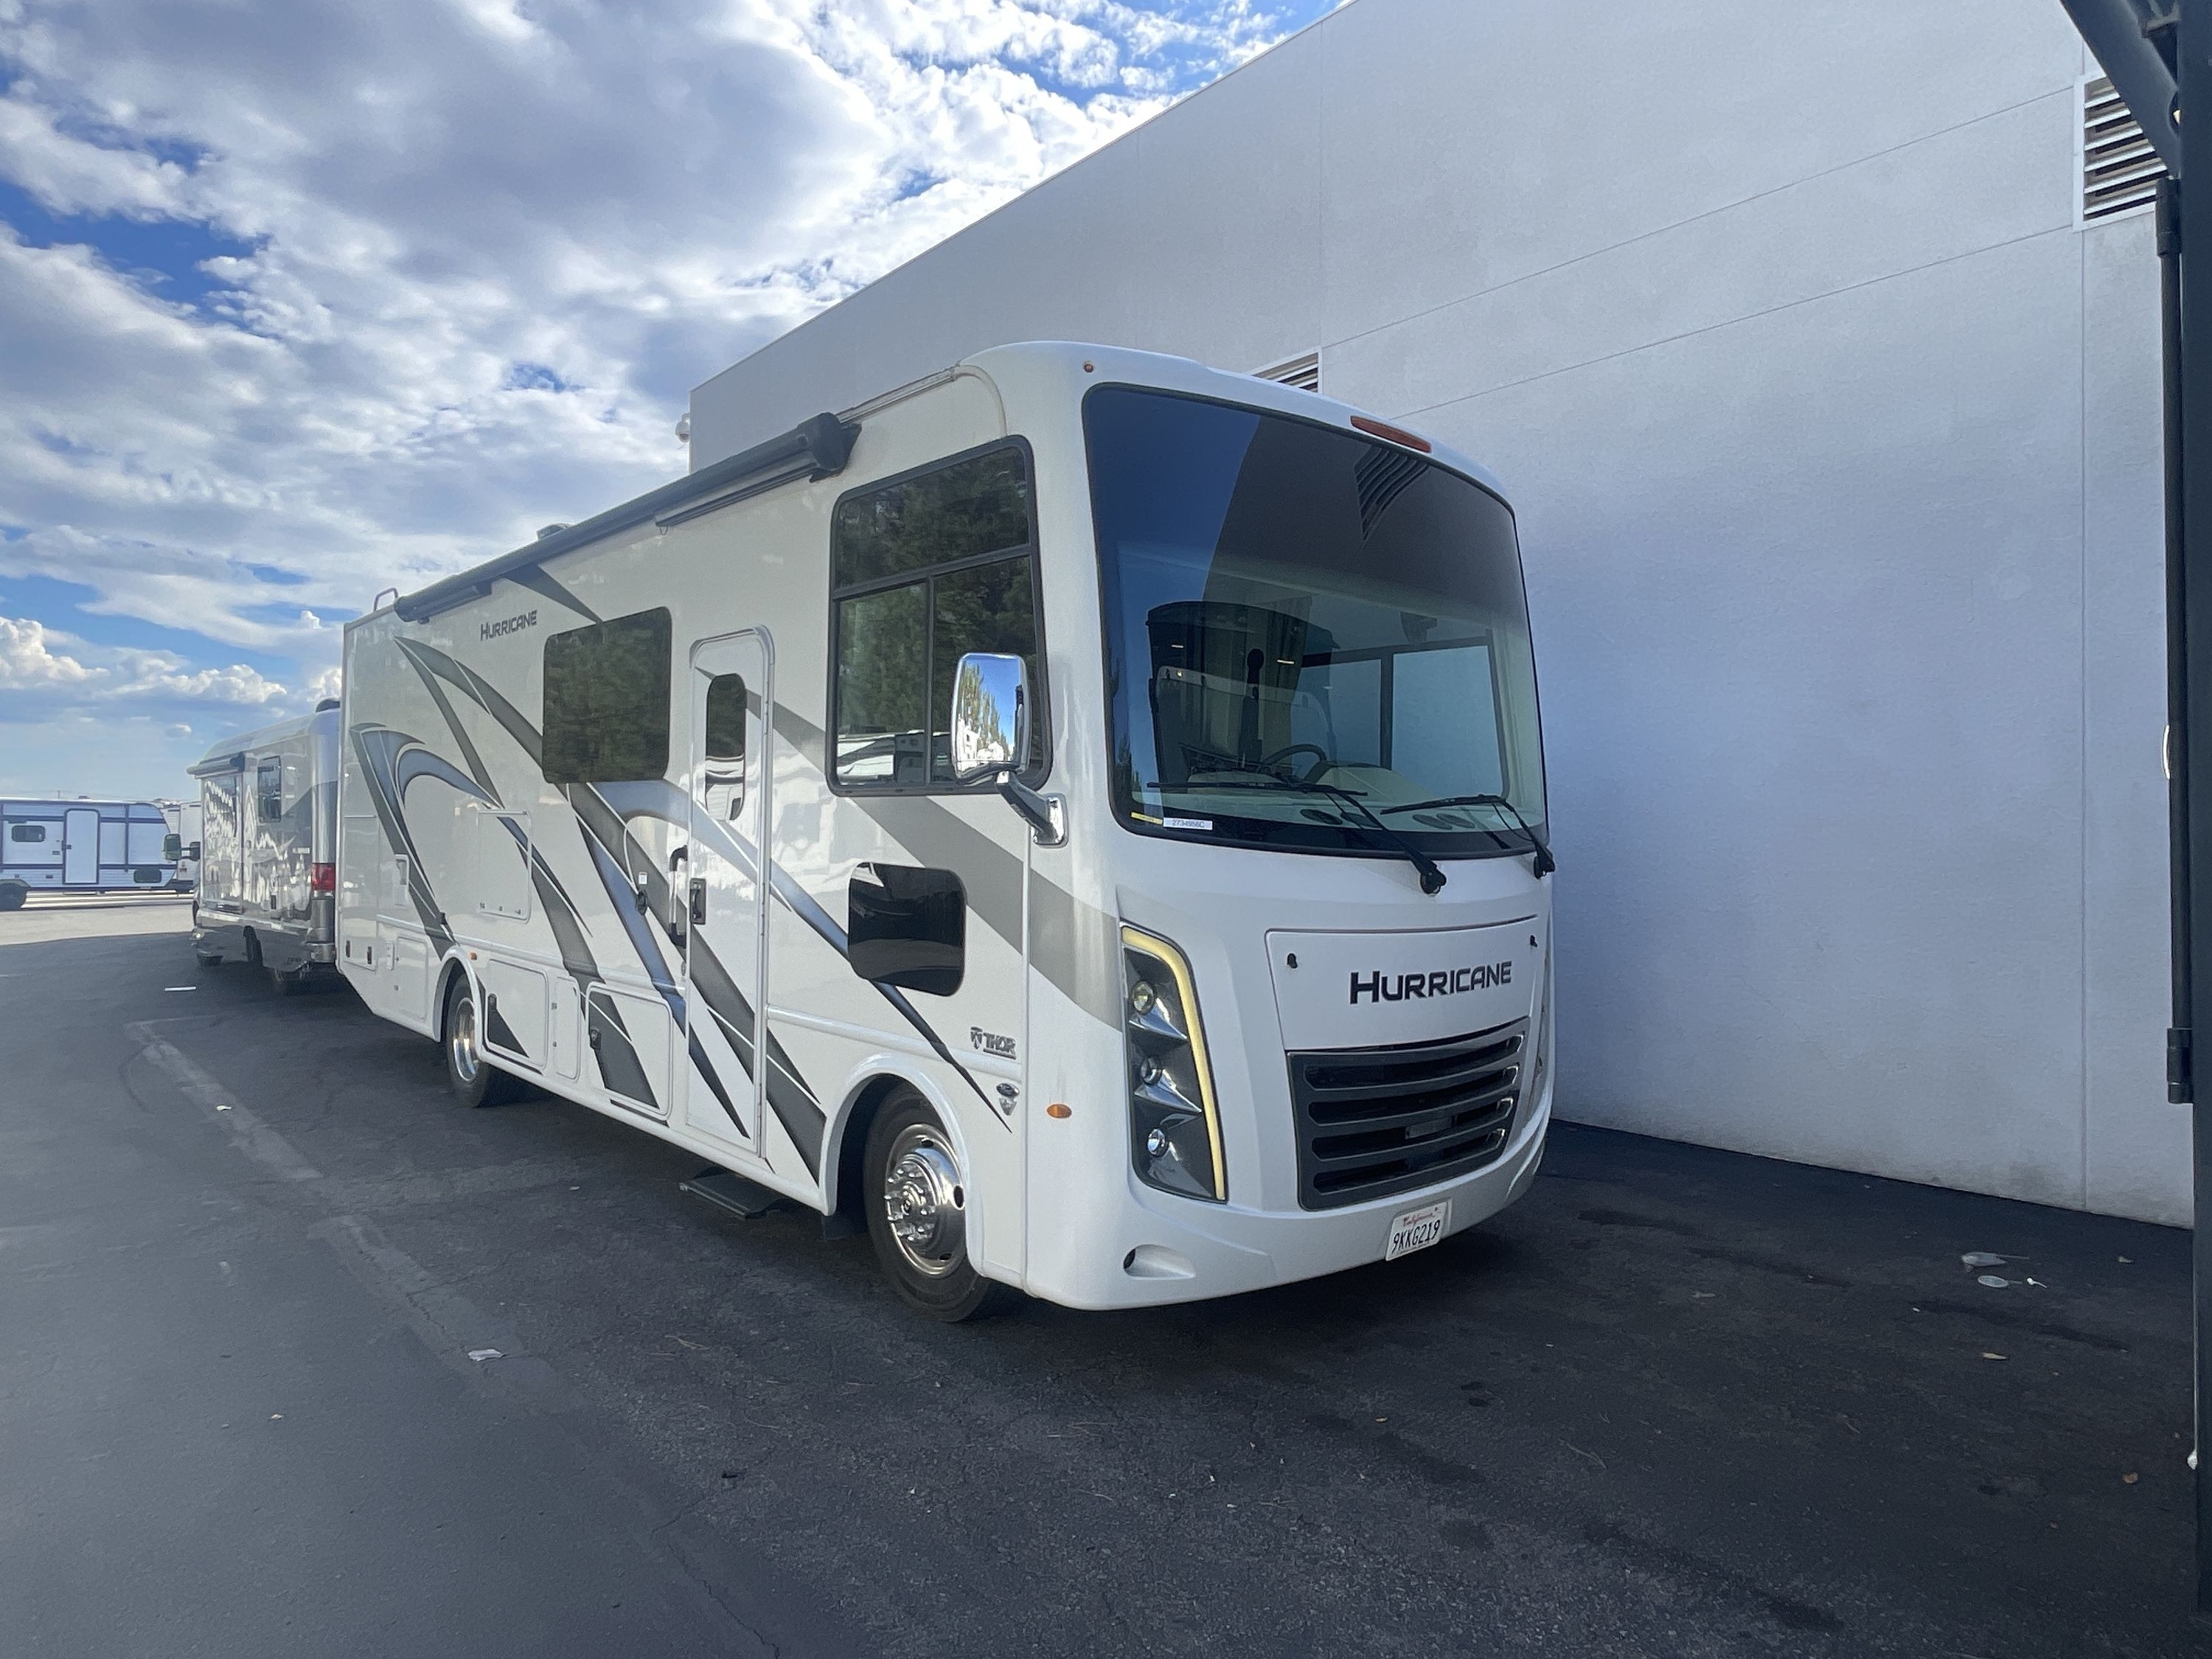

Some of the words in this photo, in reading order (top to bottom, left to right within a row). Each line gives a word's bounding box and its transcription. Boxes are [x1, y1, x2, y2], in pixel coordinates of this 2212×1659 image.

[481, 610, 538, 641] HURRICANE
[1350, 961, 1512, 1004] HURRICANE
[984, 1032, 1015, 1056] THOR
[1391, 1220, 1440, 1253] 9KKG219
